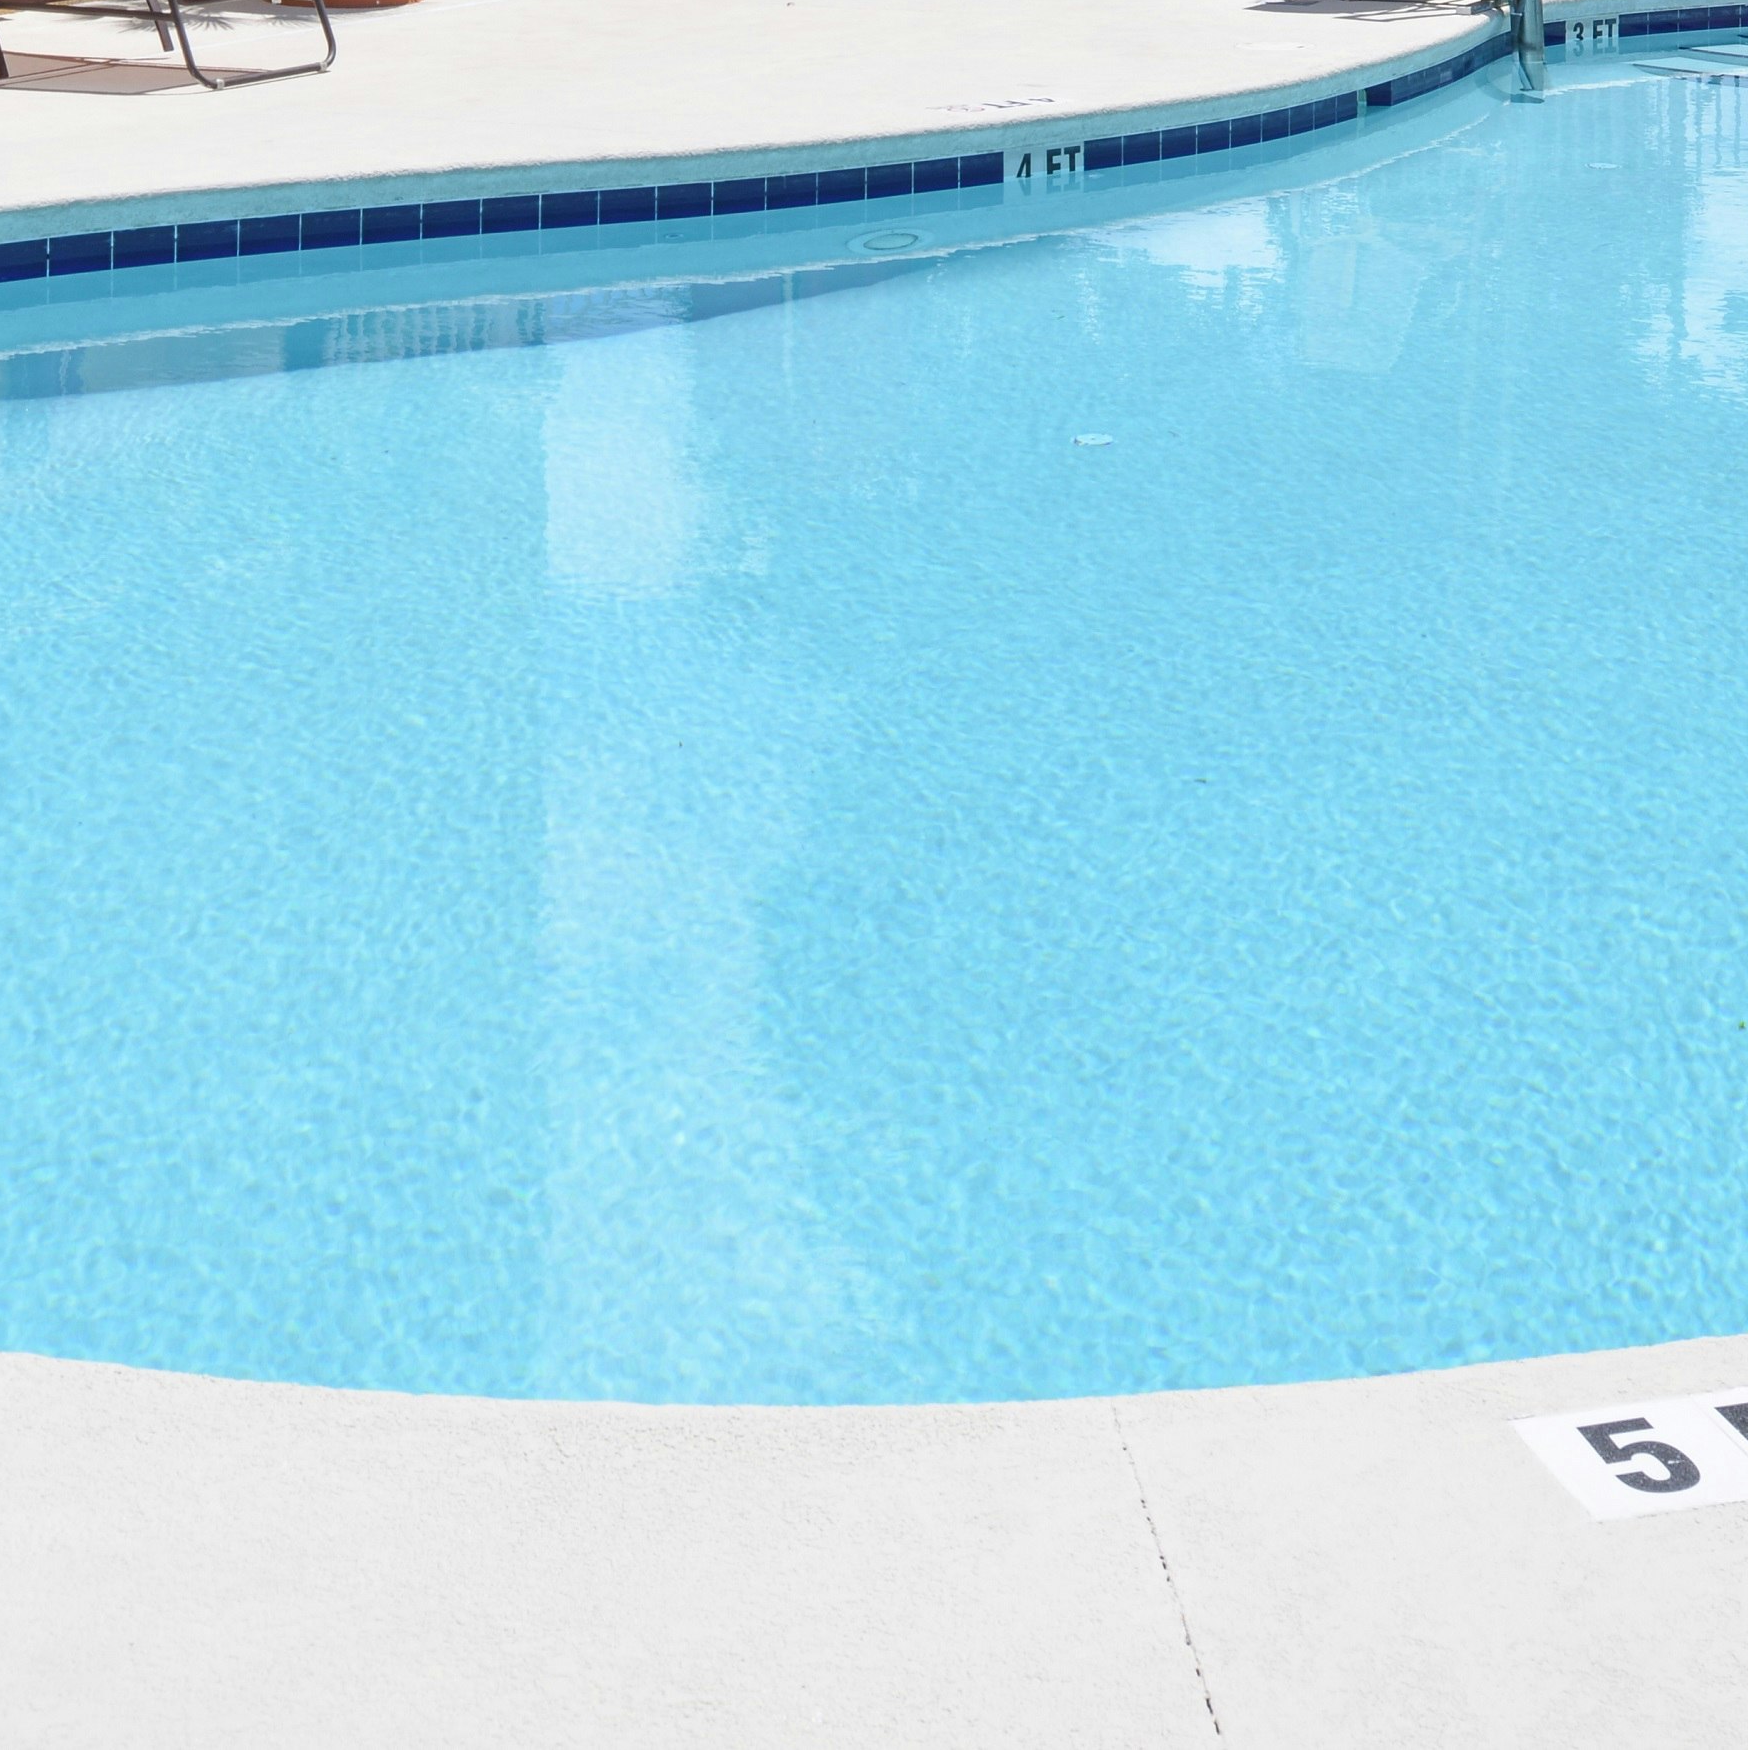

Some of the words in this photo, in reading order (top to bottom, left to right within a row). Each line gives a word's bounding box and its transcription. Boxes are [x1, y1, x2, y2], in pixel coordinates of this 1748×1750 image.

[1573, 22, 1584, 40] 3
[1593, 19, 1616, 40] FT
[1016, 153, 1031, 178] 4
[1046, 146, 1081, 175] FT
[1577, 1417, 1701, 1493] 5
